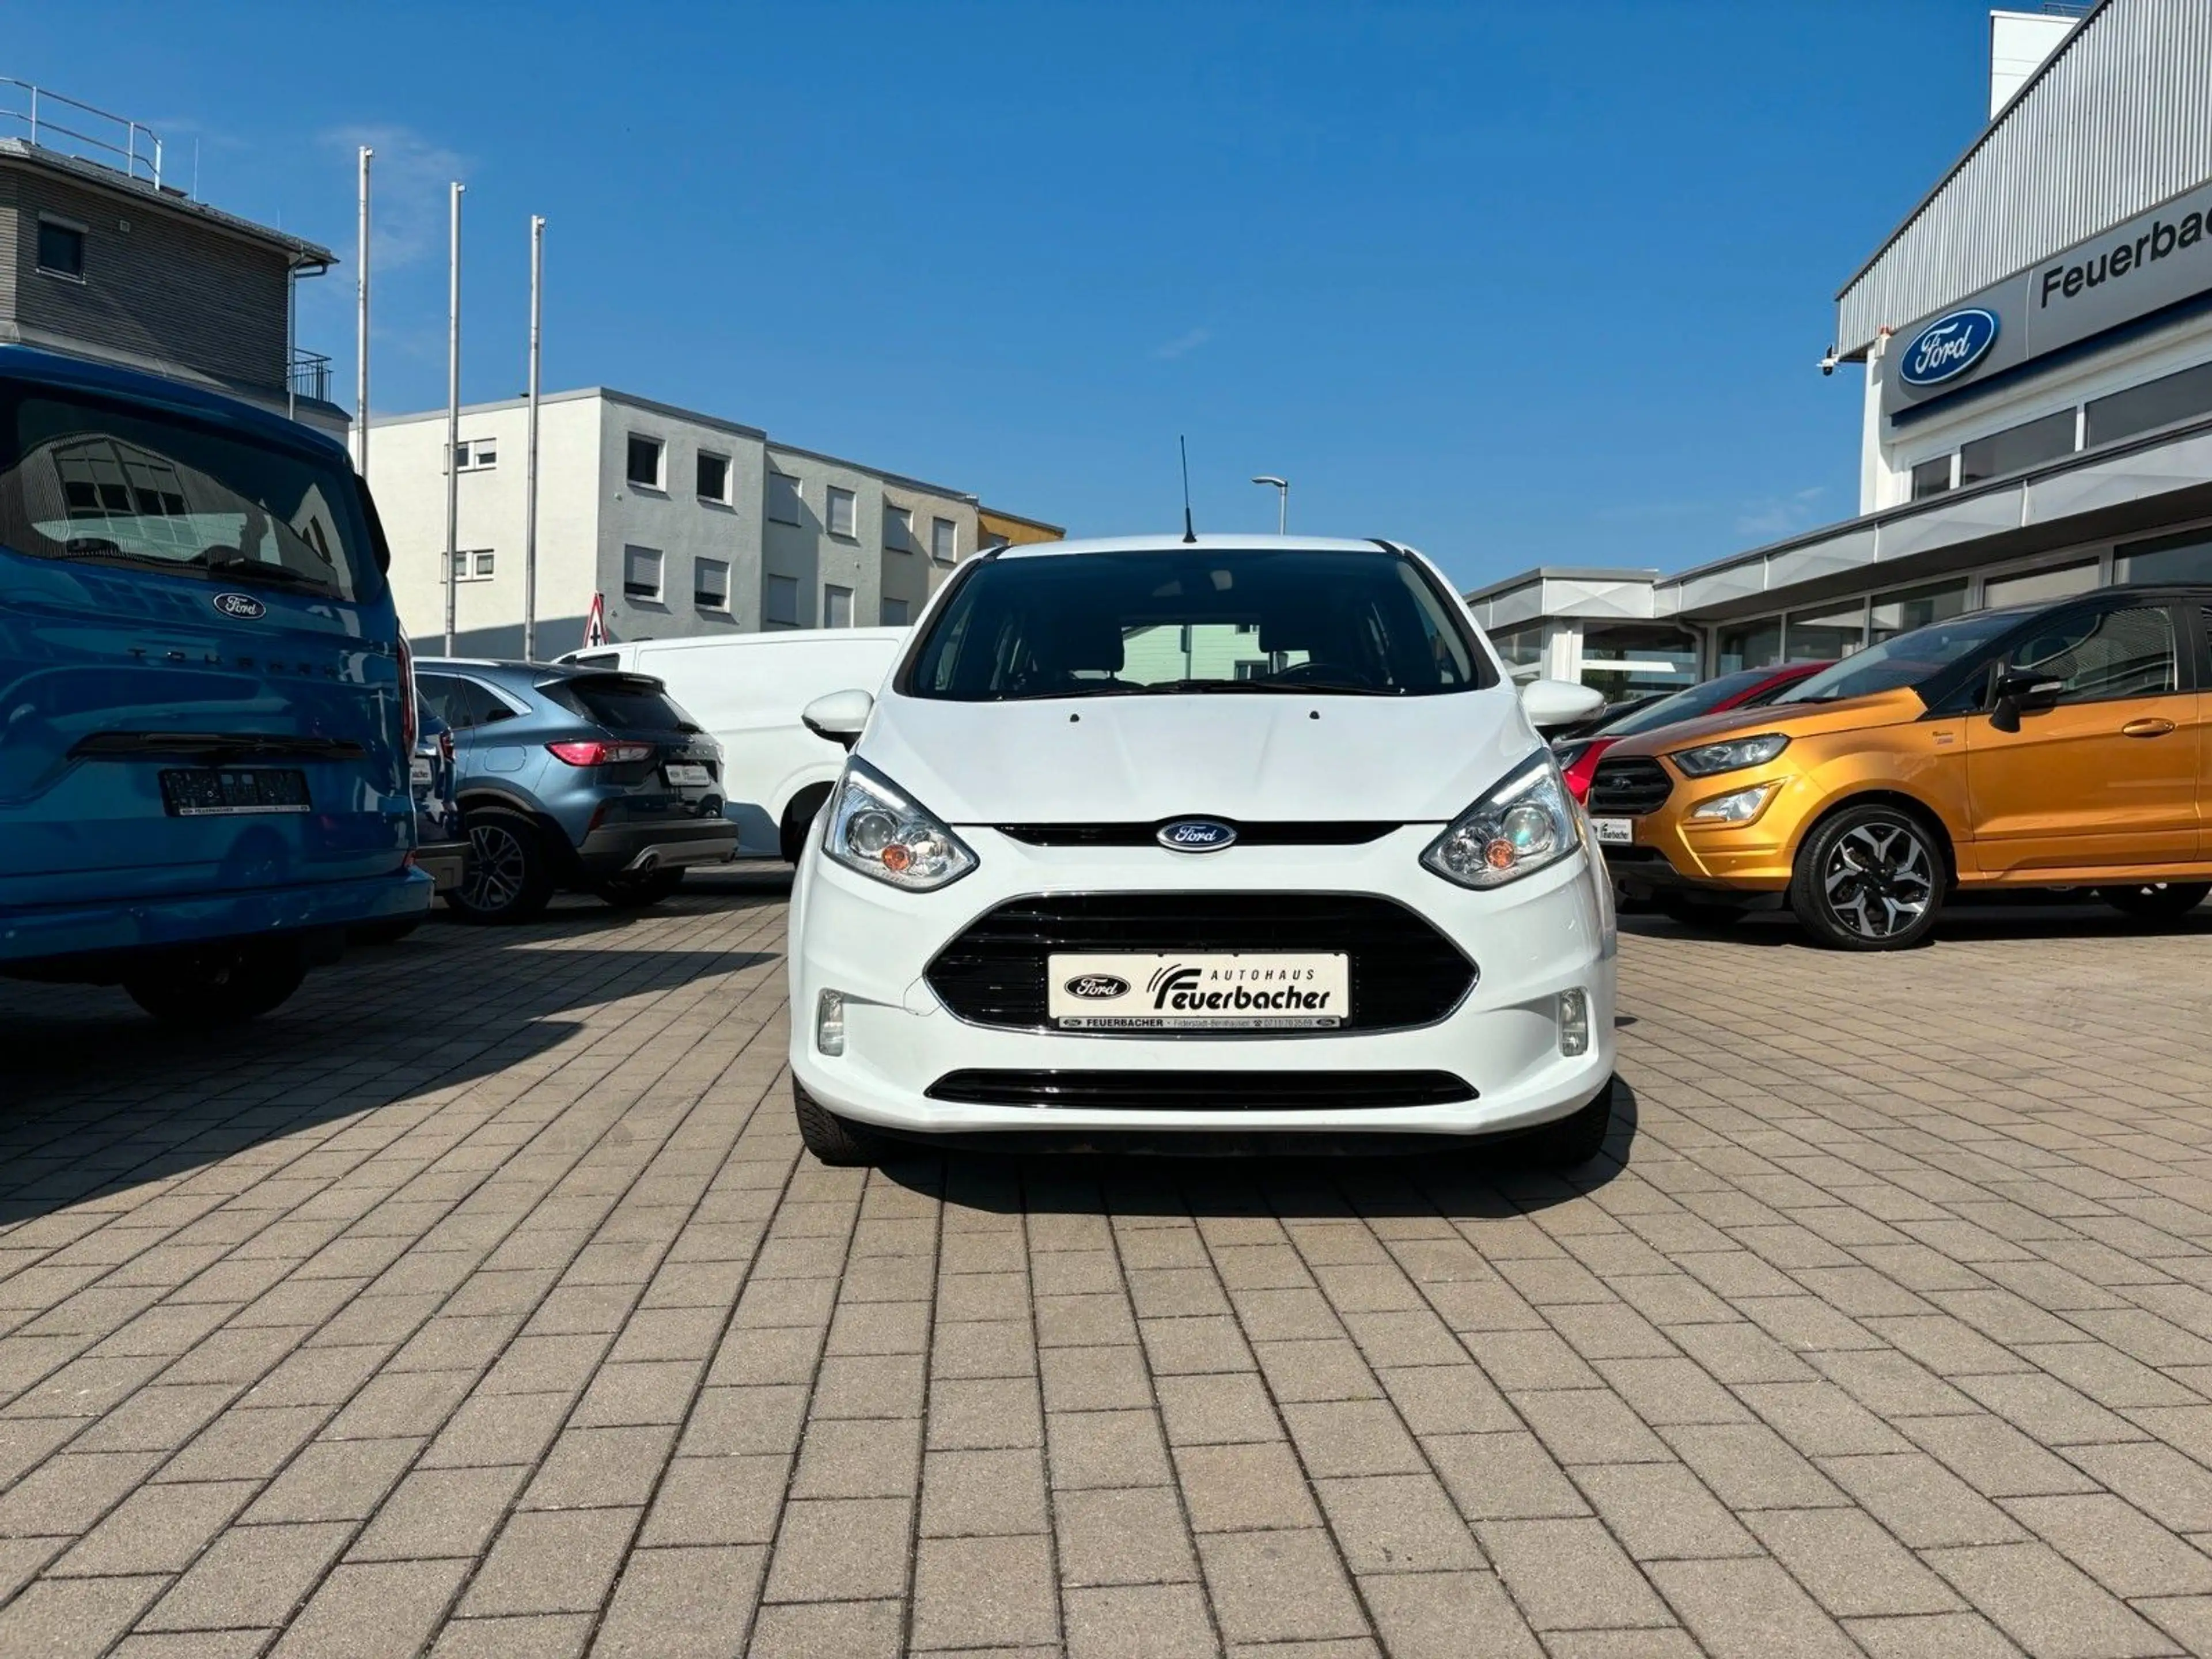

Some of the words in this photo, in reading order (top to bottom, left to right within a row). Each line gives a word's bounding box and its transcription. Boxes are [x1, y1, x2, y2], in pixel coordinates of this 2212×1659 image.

[1915, 322, 1973, 374] Ford
[225, 596, 256, 615] Ford
[1175, 825, 1217, 842] Ford
[1210, 969, 1315, 980] AUTOHAUS
[1076, 979, 1118, 995] Ford
[1153, 968, 1331, 1010] Feuerbacher
[1086, 1018, 1164, 1027] FEUERBACHER
